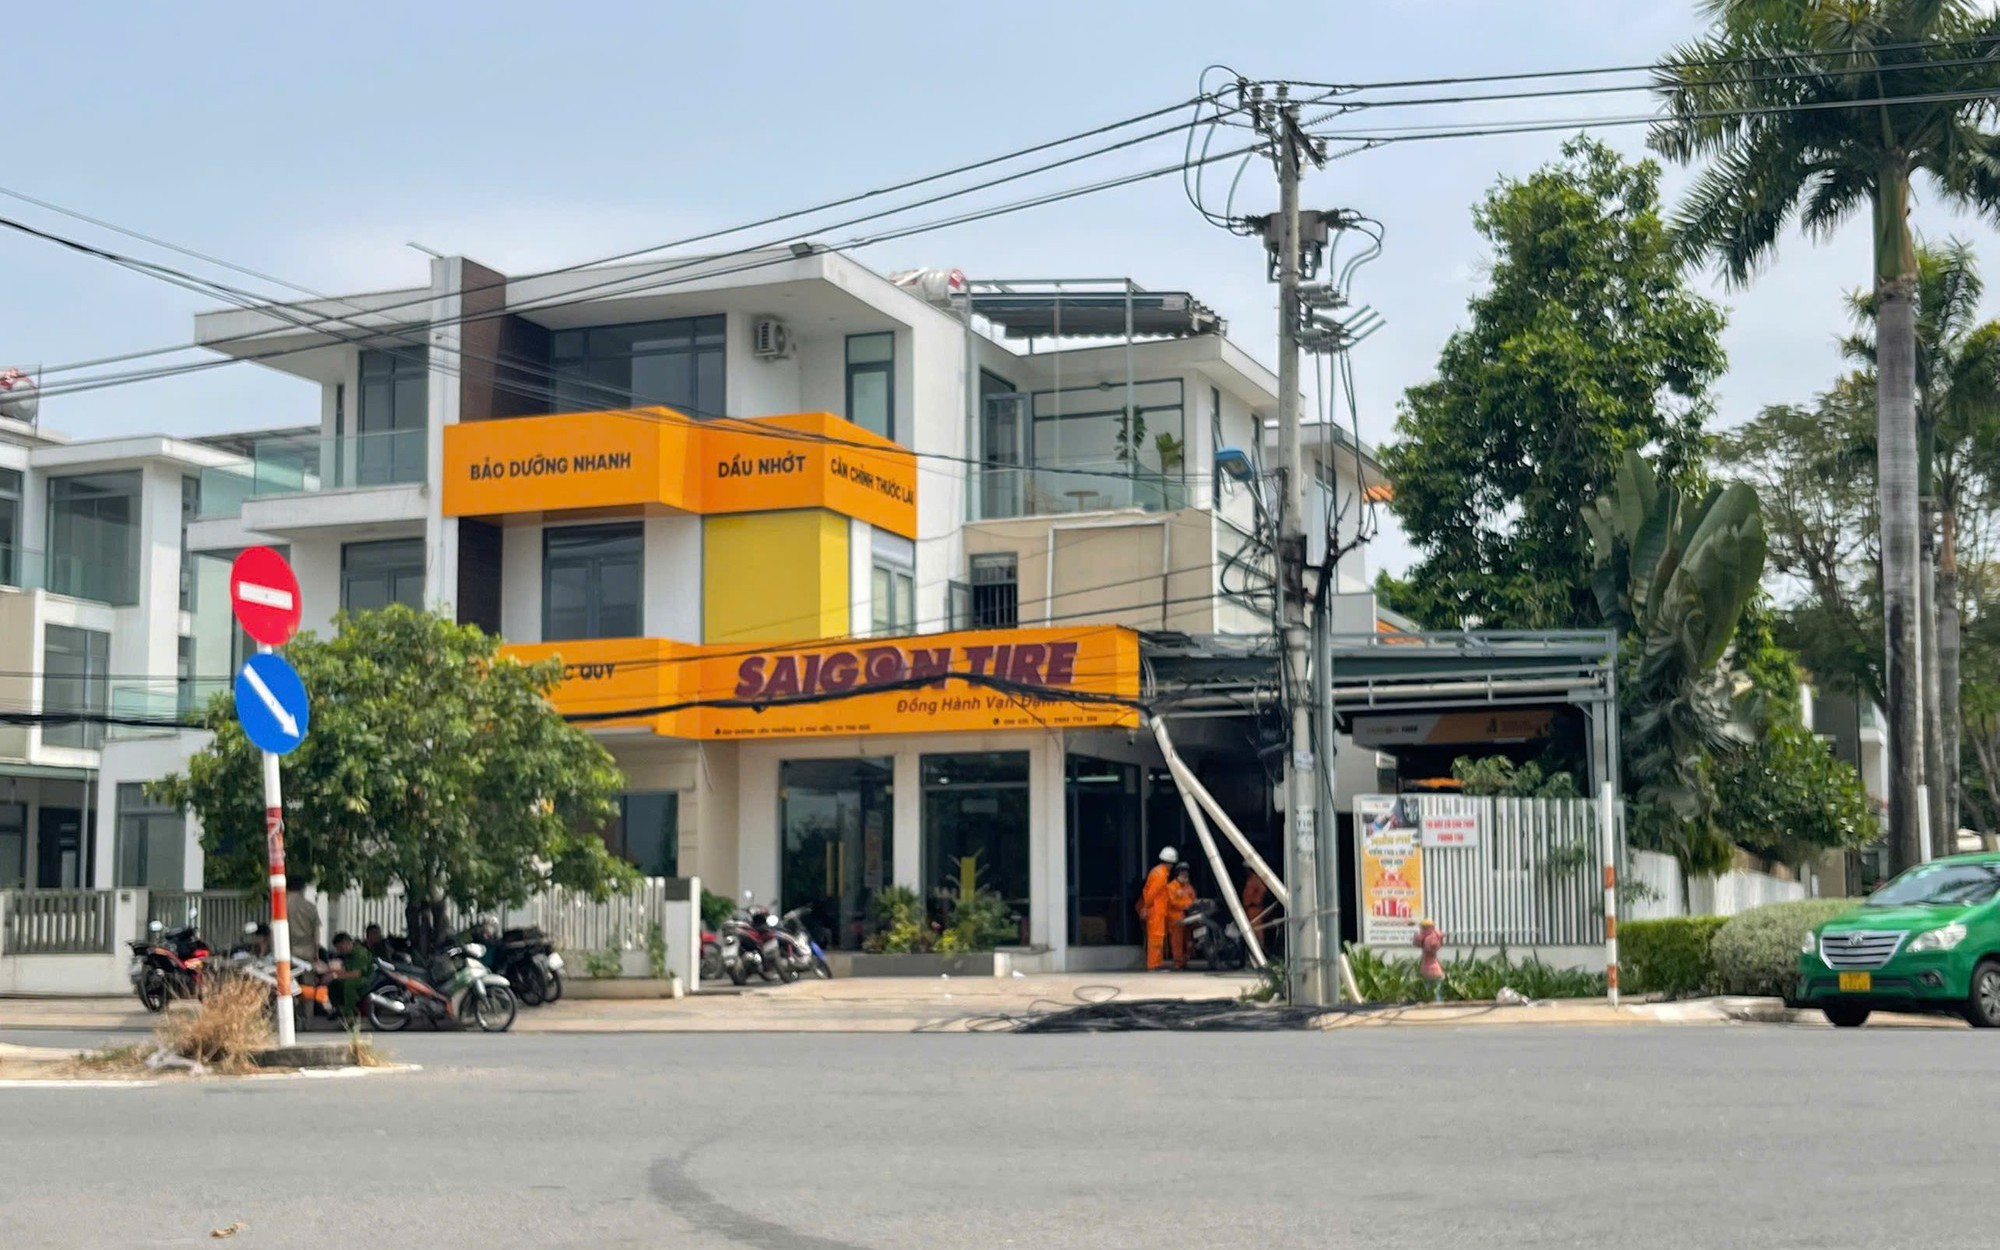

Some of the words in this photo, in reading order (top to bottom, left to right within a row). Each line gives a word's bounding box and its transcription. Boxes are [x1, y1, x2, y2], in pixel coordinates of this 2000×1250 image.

[470, 457, 504, 480] BẢO
[510, 454, 568, 477] DƯỠNG
[573, 452, 631, 472] NHANH
[735, 645, 951, 699] SAIGON
[963, 641, 1078, 688] TIRE
